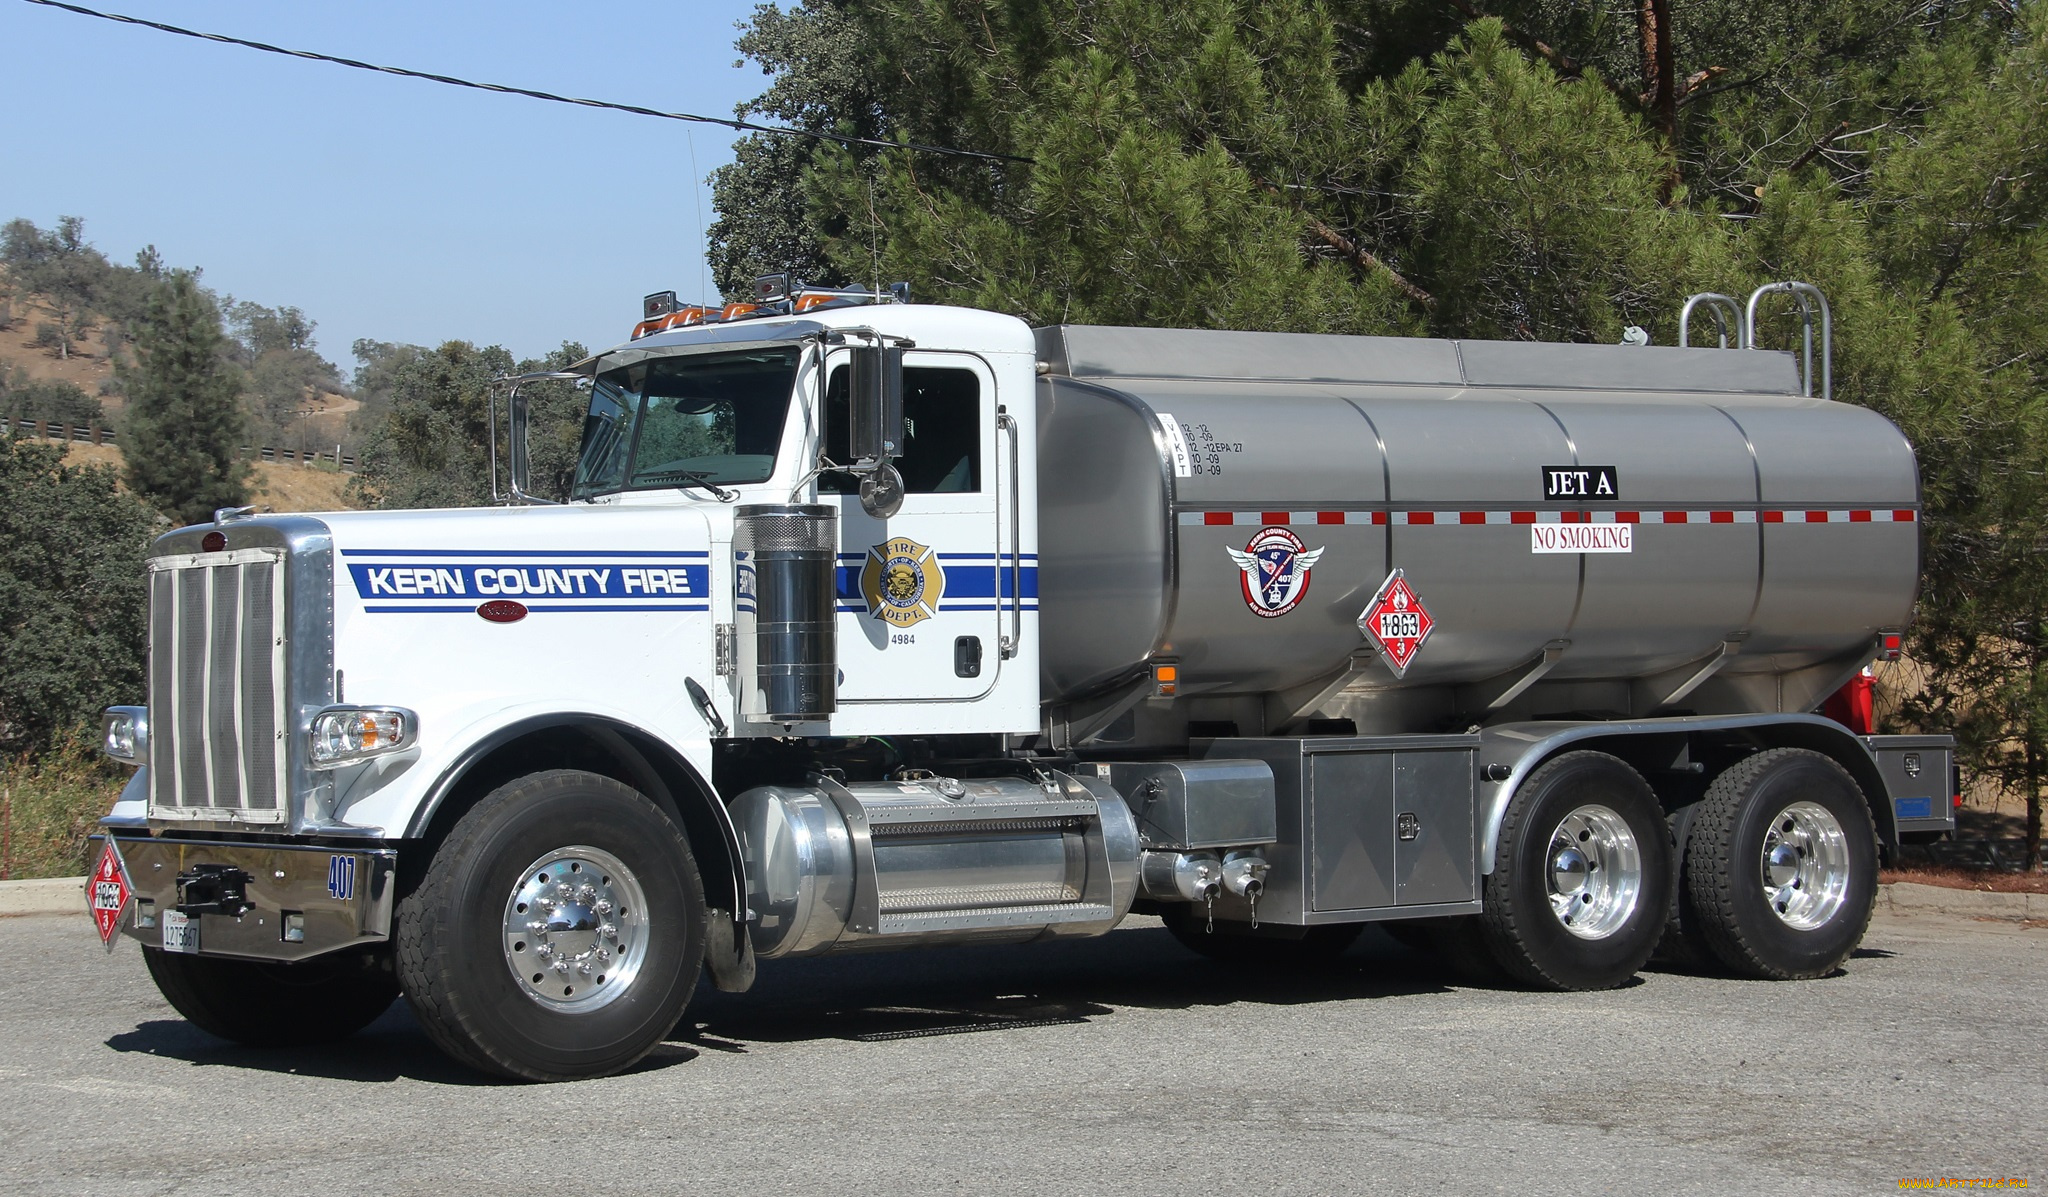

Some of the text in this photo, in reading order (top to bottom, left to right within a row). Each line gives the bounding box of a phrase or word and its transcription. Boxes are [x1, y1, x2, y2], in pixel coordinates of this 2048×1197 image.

[1167, 423, 1209, 432] V 12 -12
[1185, 432, 1195, 441] 10
[1200, 432, 1214, 441] -09
[1174, 443, 1183, 452] K
[1189, 442, 1199, 452] 12
[1233, 443, 1243, 452] 27
[1178, 453, 1220, 463] P 10 -09
[1179, 464, 1221, 475] T 10 -09
[1549, 471, 1614, 495] JET A
[1250, 528, 1303, 550] KERN COUNTY FIRE
[1533, 526, 1630, 549] NO SMOKING
[885, 543, 918, 556] FIRE
[367, 568, 692, 595] KERN COUNTY FIRE
[1278, 574, 1292, 583] 407
[885, 608, 922, 622] DEPT.
[1249, 601, 1296, 617] AIR OPERATIONS
[1382, 614, 1418, 636] 1863
[891, 634, 916, 645] 4984
[1396, 642, 1406, 656] 3
[328, 854, 356, 900] 407
[102, 914, 109, 930] 3
